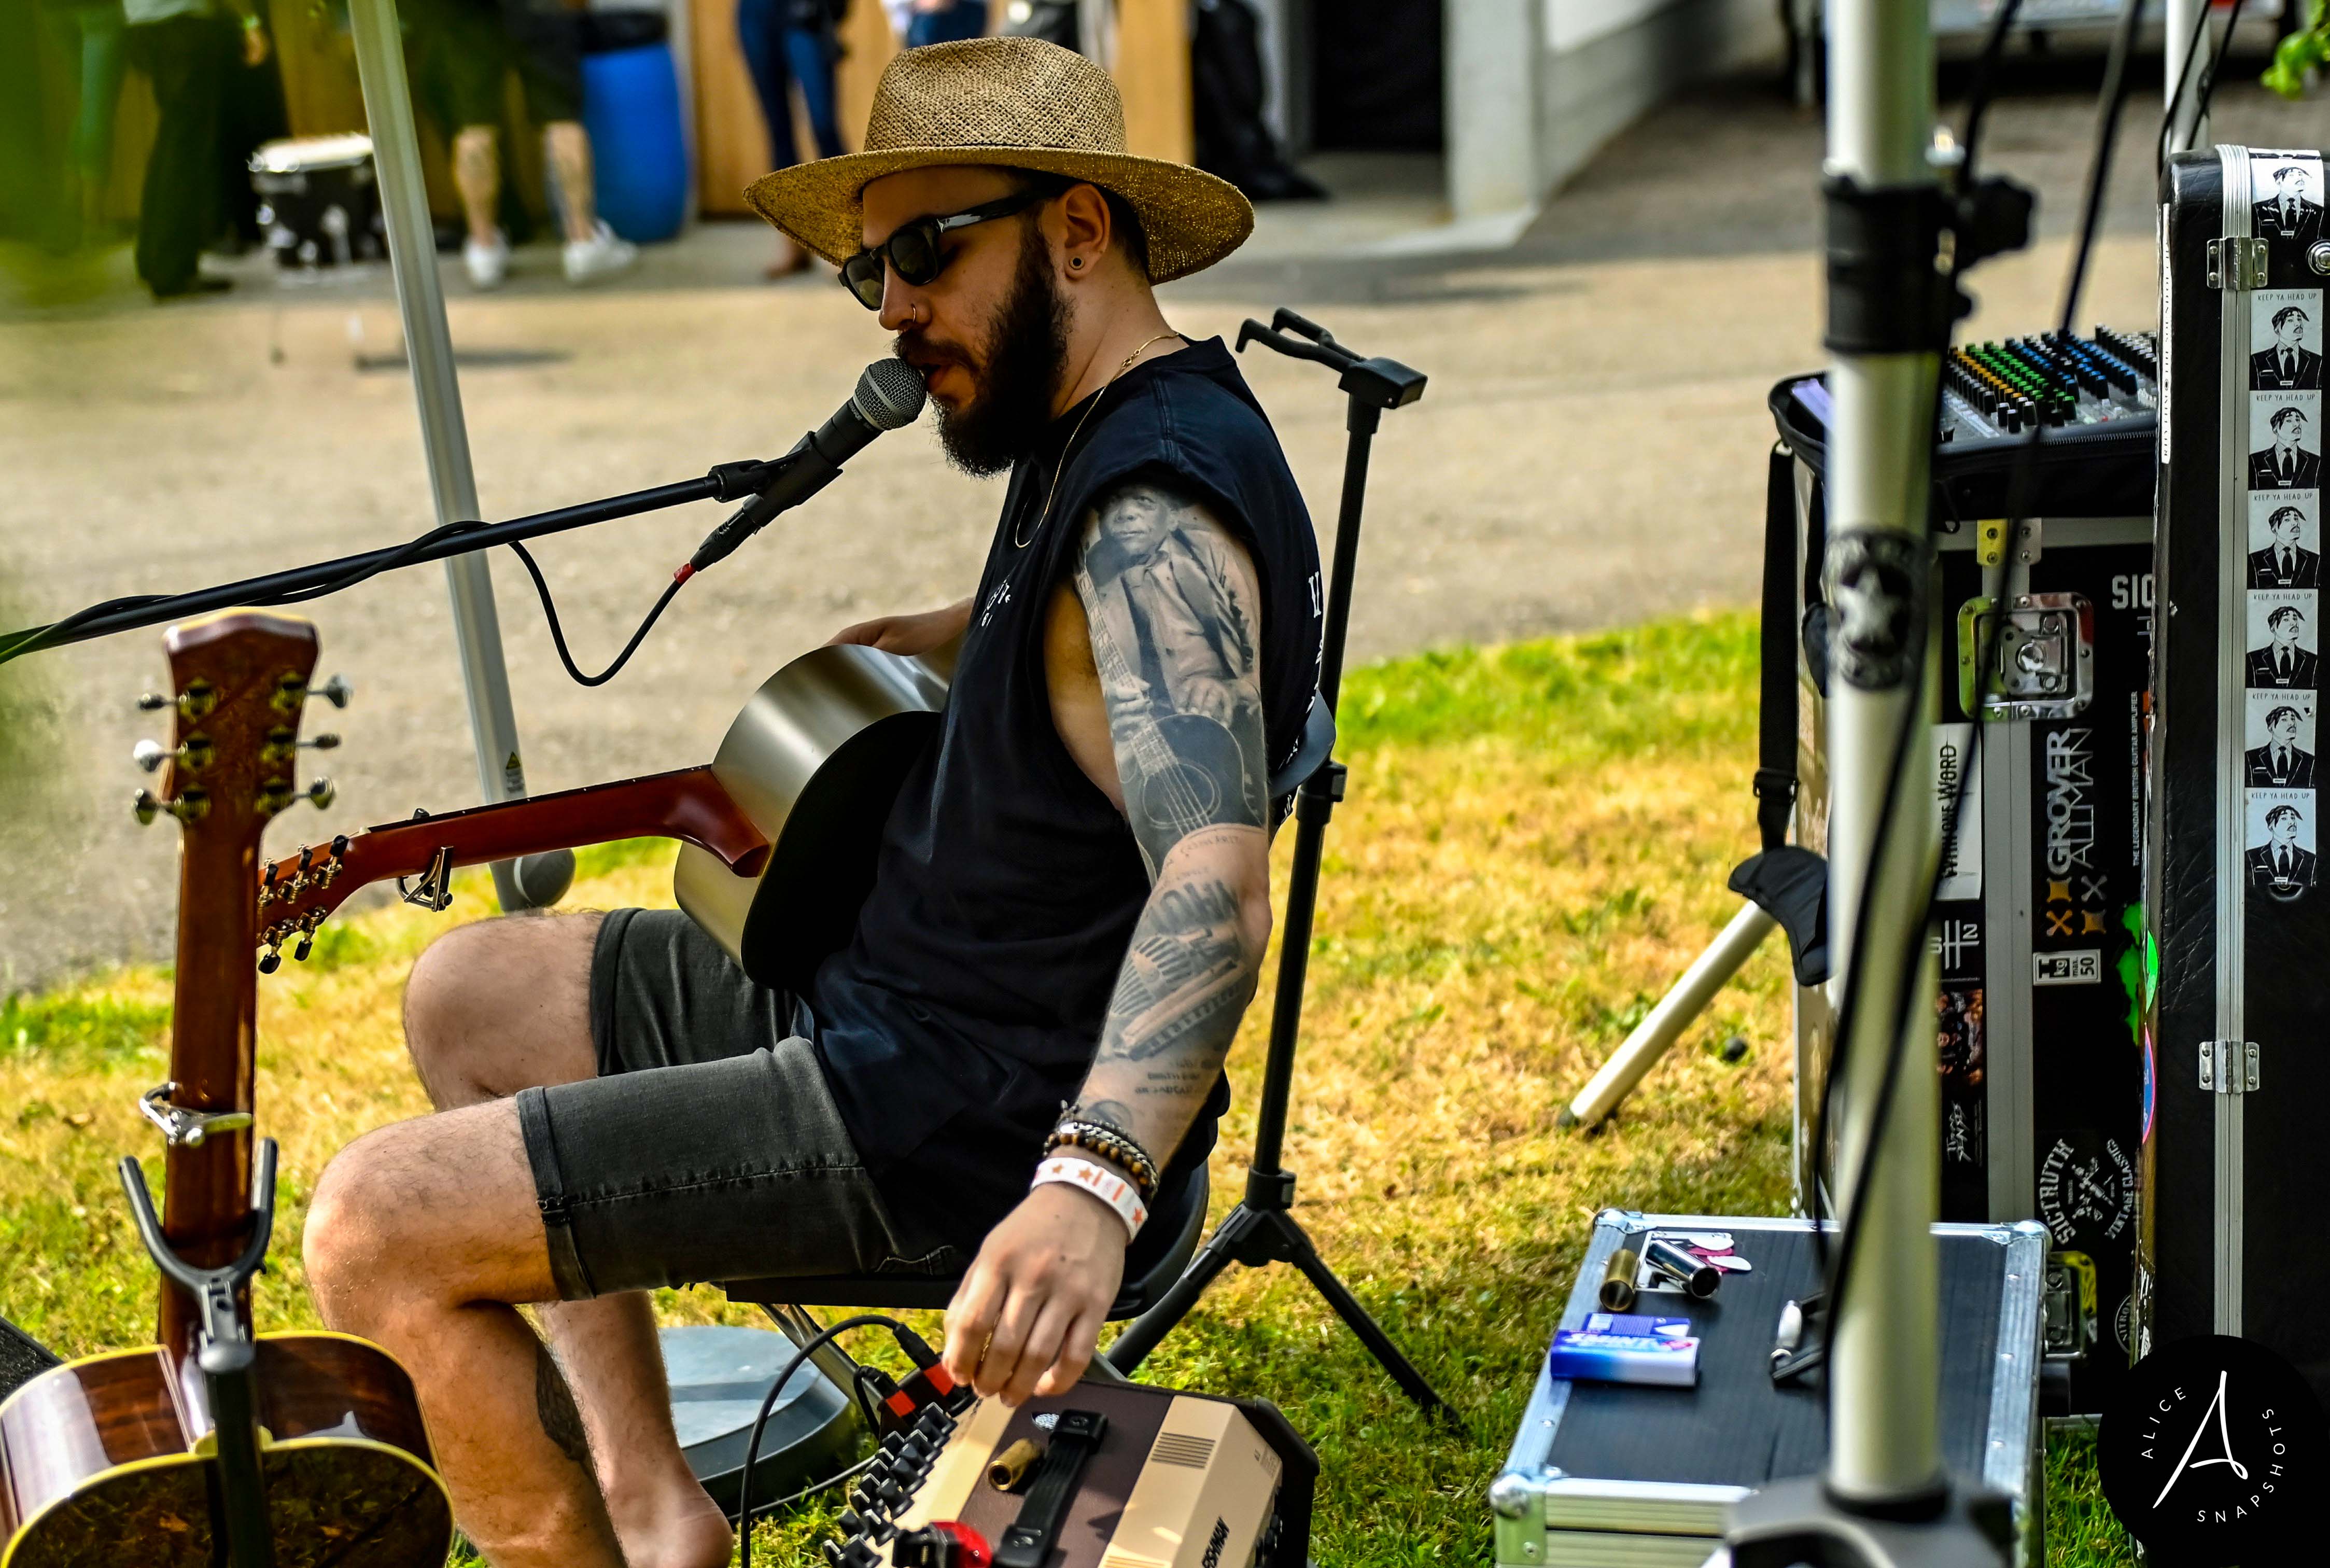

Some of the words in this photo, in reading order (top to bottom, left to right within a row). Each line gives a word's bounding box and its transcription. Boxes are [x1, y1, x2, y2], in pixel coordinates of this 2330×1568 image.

[2257, 293, 2273, 302] KEEP
[2287, 292, 2305, 301] HEAD
[2274, 394, 2283, 402] YA
[2283, 493, 2303, 501] HEAD
[2253, 593, 2269, 601] KEEP
[2272, 593, 2280, 601] YA
[2283, 593, 2300, 601] HEAD
[1937, 745, 1957, 801] WORD
[2047, 727, 2071, 875] GROVER
[2070, 728, 2094, 869] ALLMAN
[2053, 959, 2068, 976] kg
[2080, 957, 2095, 976] 50
[2106, 1138, 2134, 1187] CLASSICS
[2039, 1138, 2076, 1244] SICTRUTH
[2104, 1191, 2134, 1240] VINTAGE
